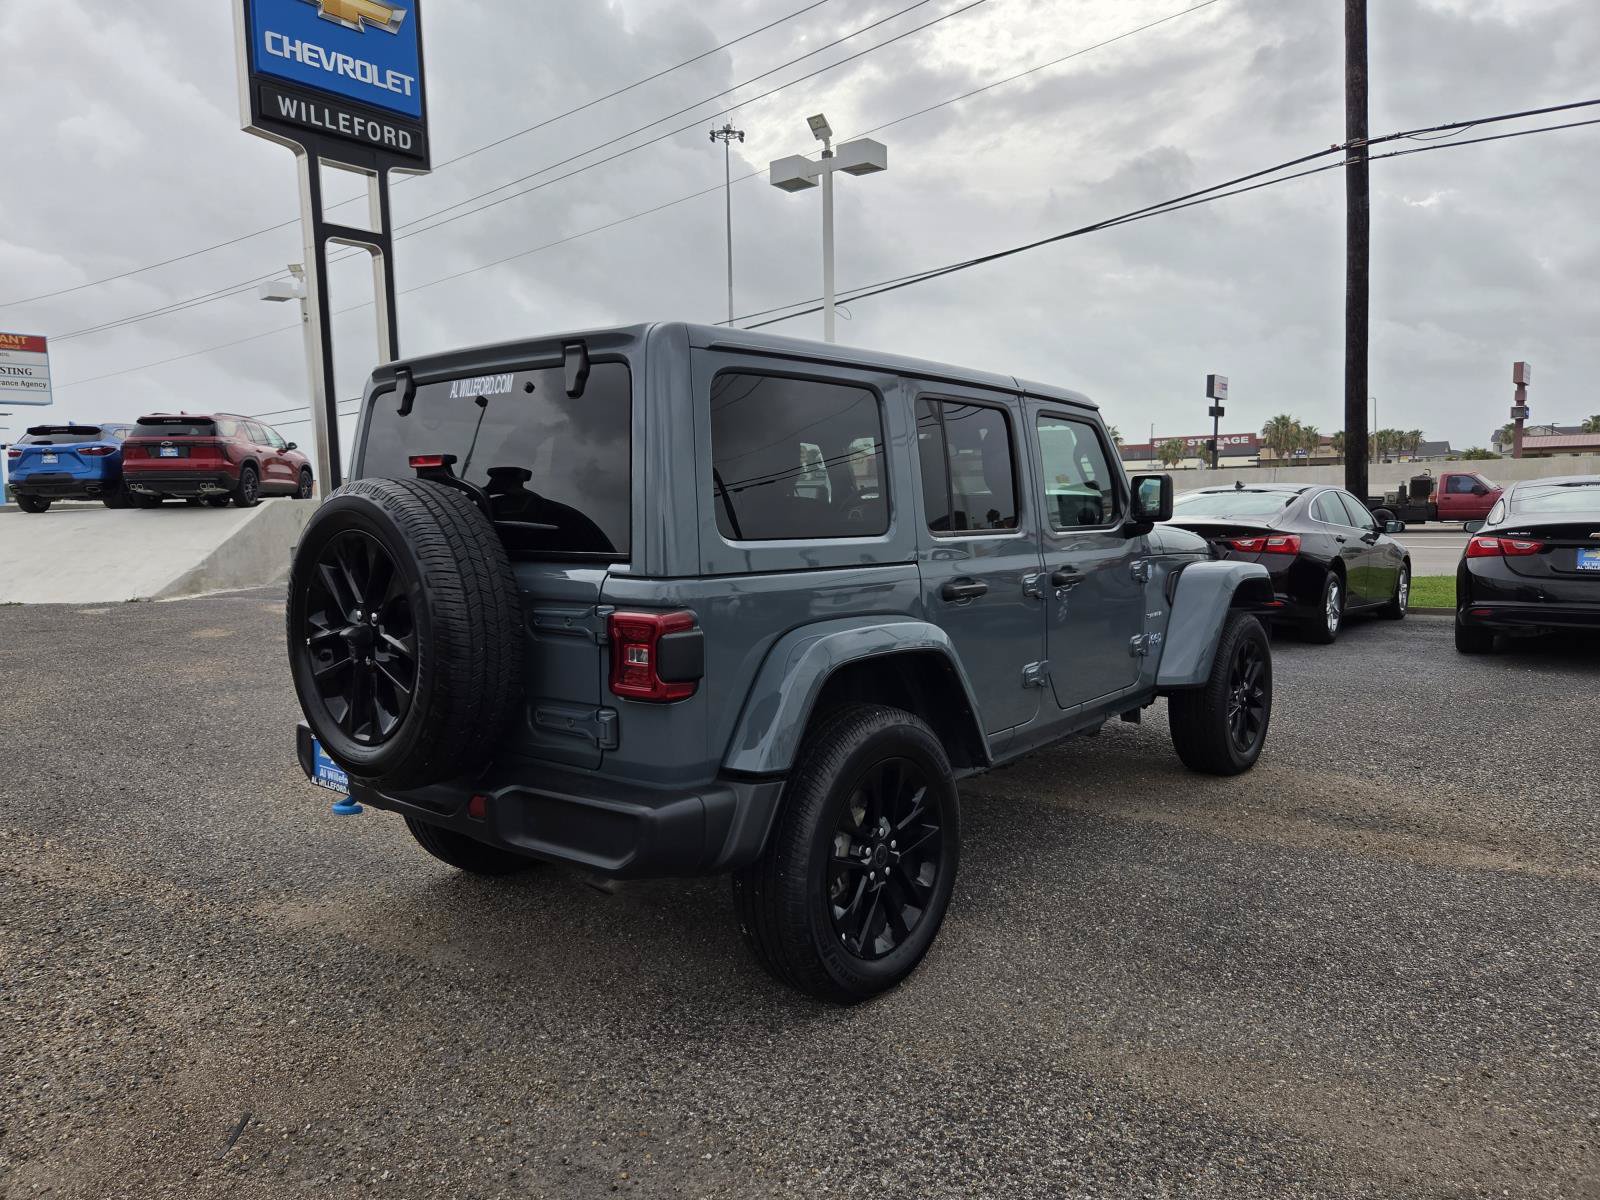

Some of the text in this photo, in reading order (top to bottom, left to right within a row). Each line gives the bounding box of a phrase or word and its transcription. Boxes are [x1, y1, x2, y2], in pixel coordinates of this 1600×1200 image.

[264, 30, 415, 97] CHEVROLET
[277, 95, 412, 150] WILLEFORD
[21, 380, 47, 388] Agency
[459, 373, 514, 398] WILLEFORD.COM
